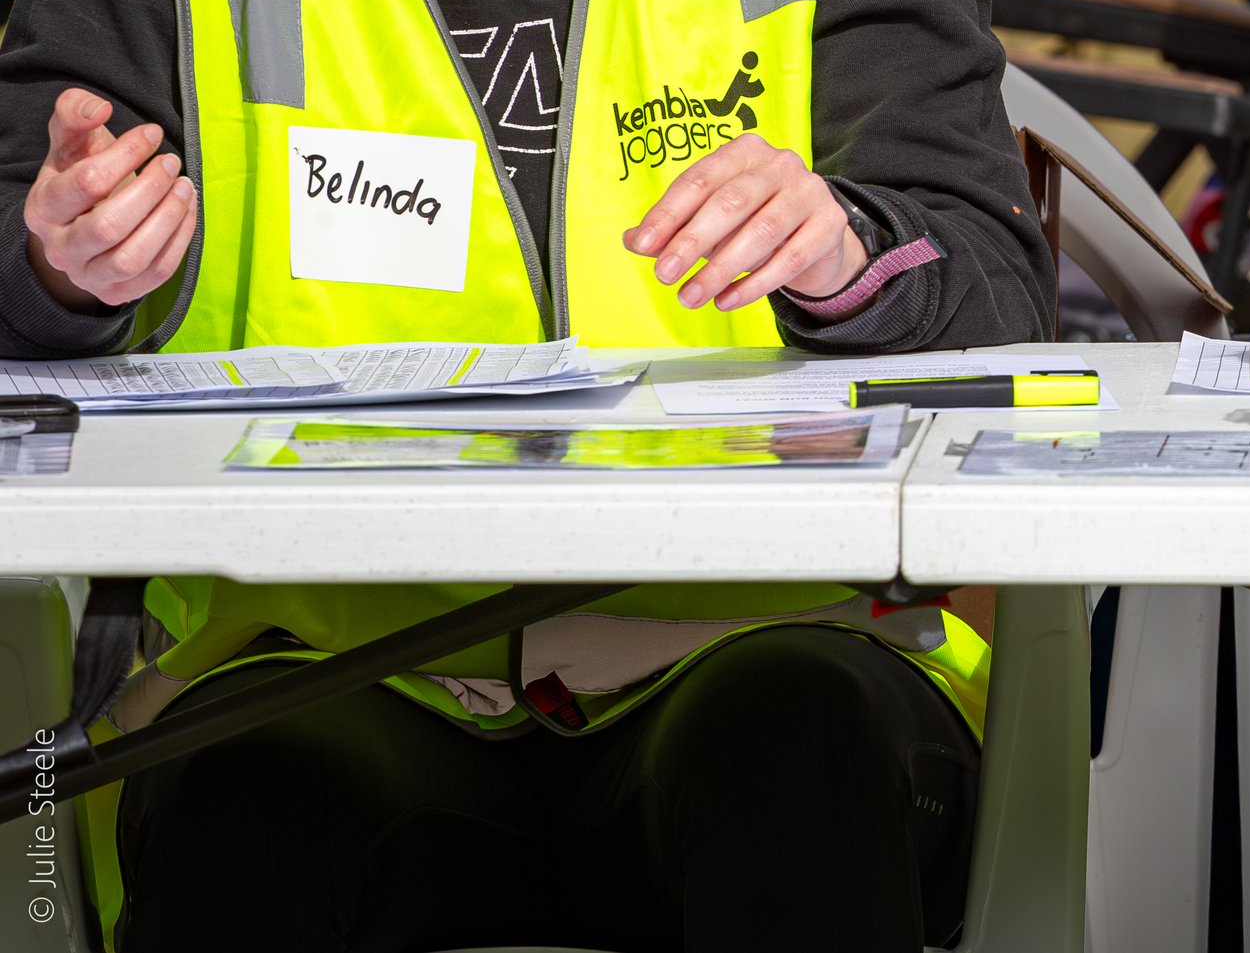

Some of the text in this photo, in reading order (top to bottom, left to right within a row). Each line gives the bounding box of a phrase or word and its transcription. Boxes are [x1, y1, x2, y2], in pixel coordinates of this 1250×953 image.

[612, 85, 707, 137] kembla
[619, 122, 734, 182] joggers
[302, 153, 442, 226] Belinda
